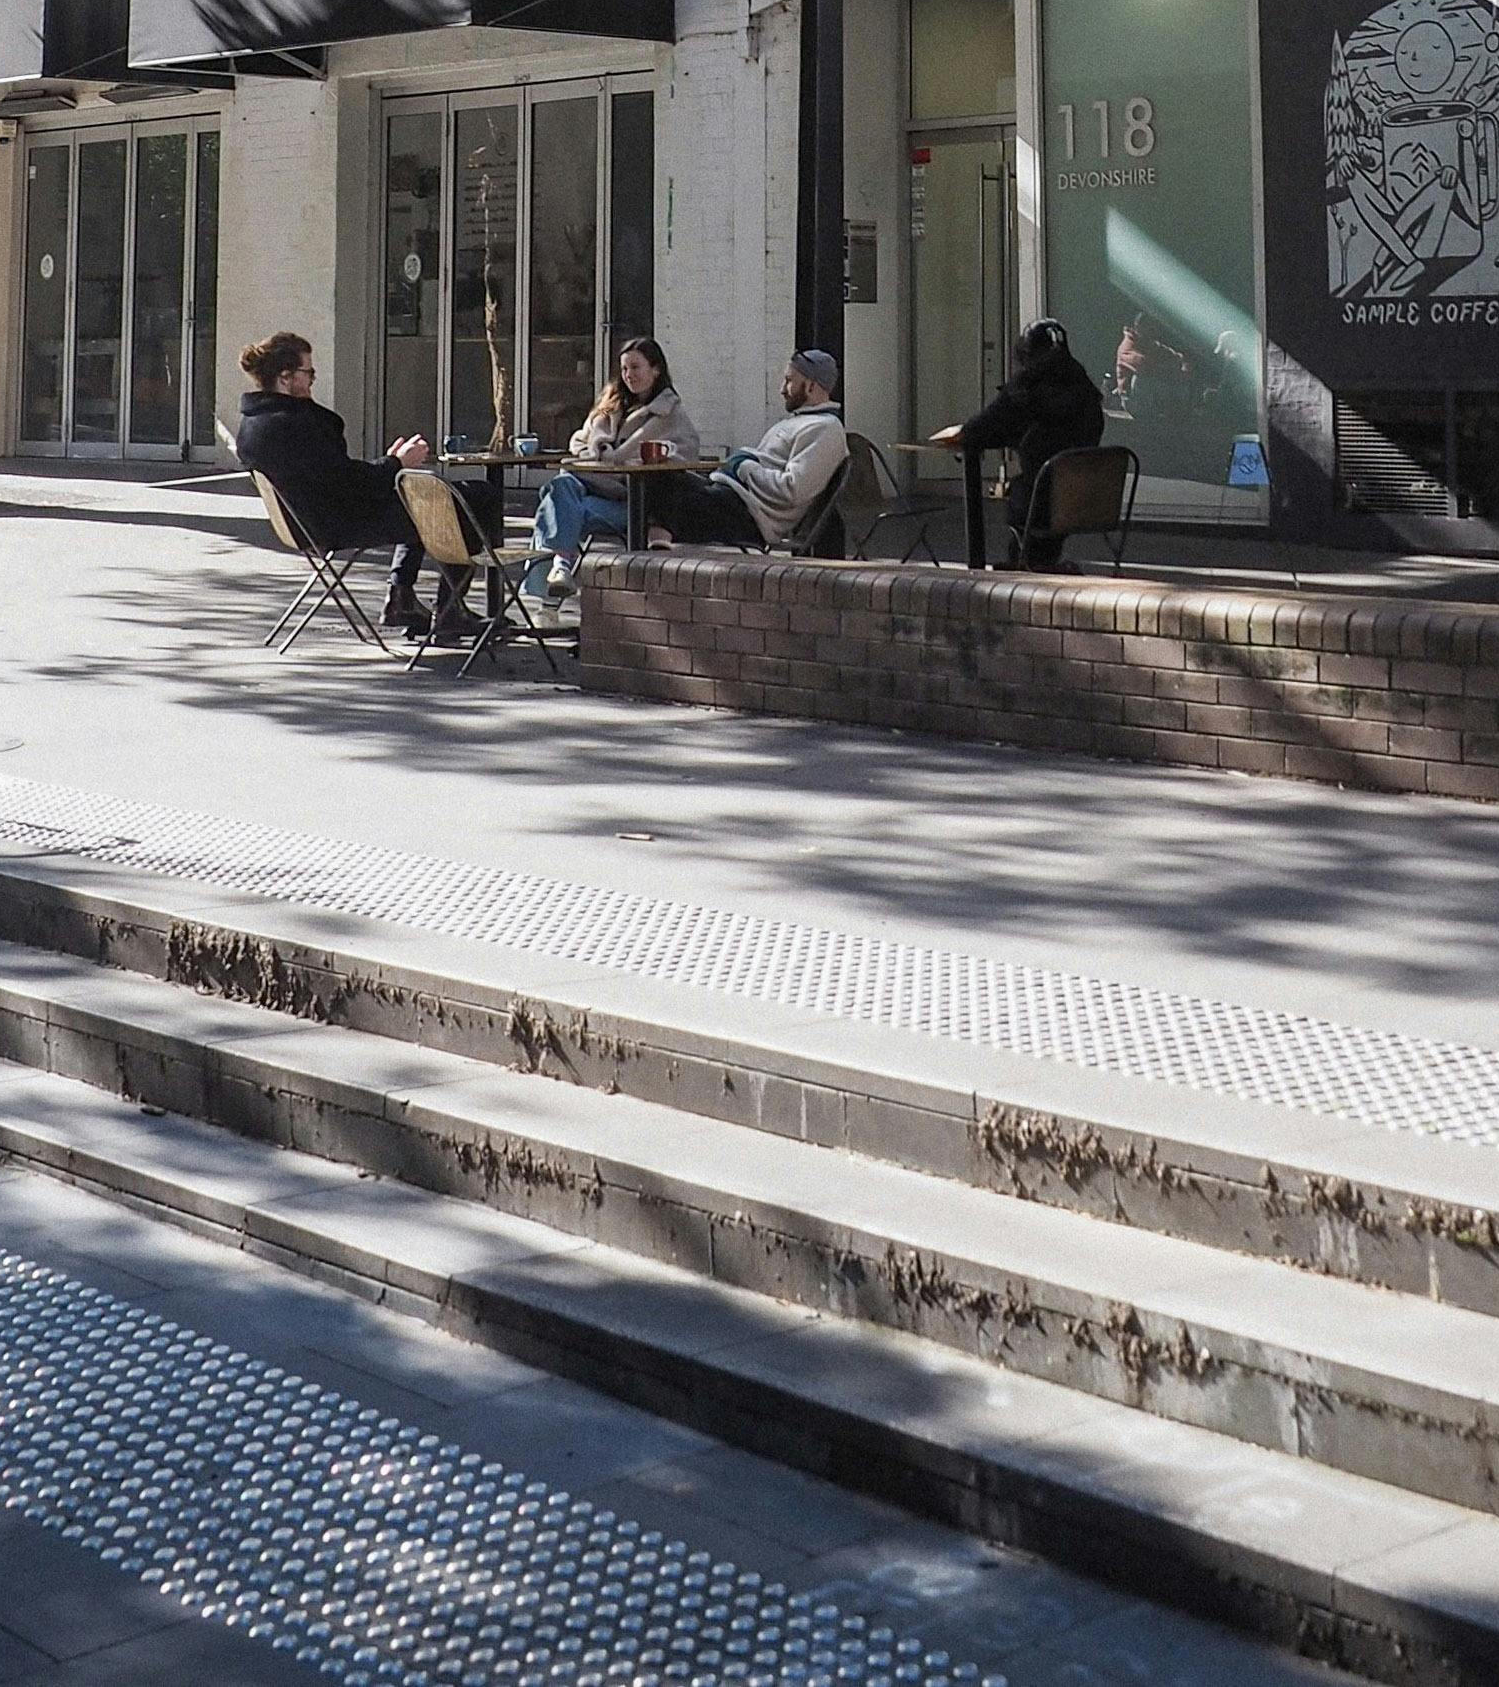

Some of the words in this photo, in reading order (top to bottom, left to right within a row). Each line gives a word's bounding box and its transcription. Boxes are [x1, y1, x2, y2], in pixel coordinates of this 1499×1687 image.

[1058, 97, 1155, 160] 118
[1058, 167, 1156, 190] DEVONSHIRE
[1342, 302, 1420, 326] SAMPLE
